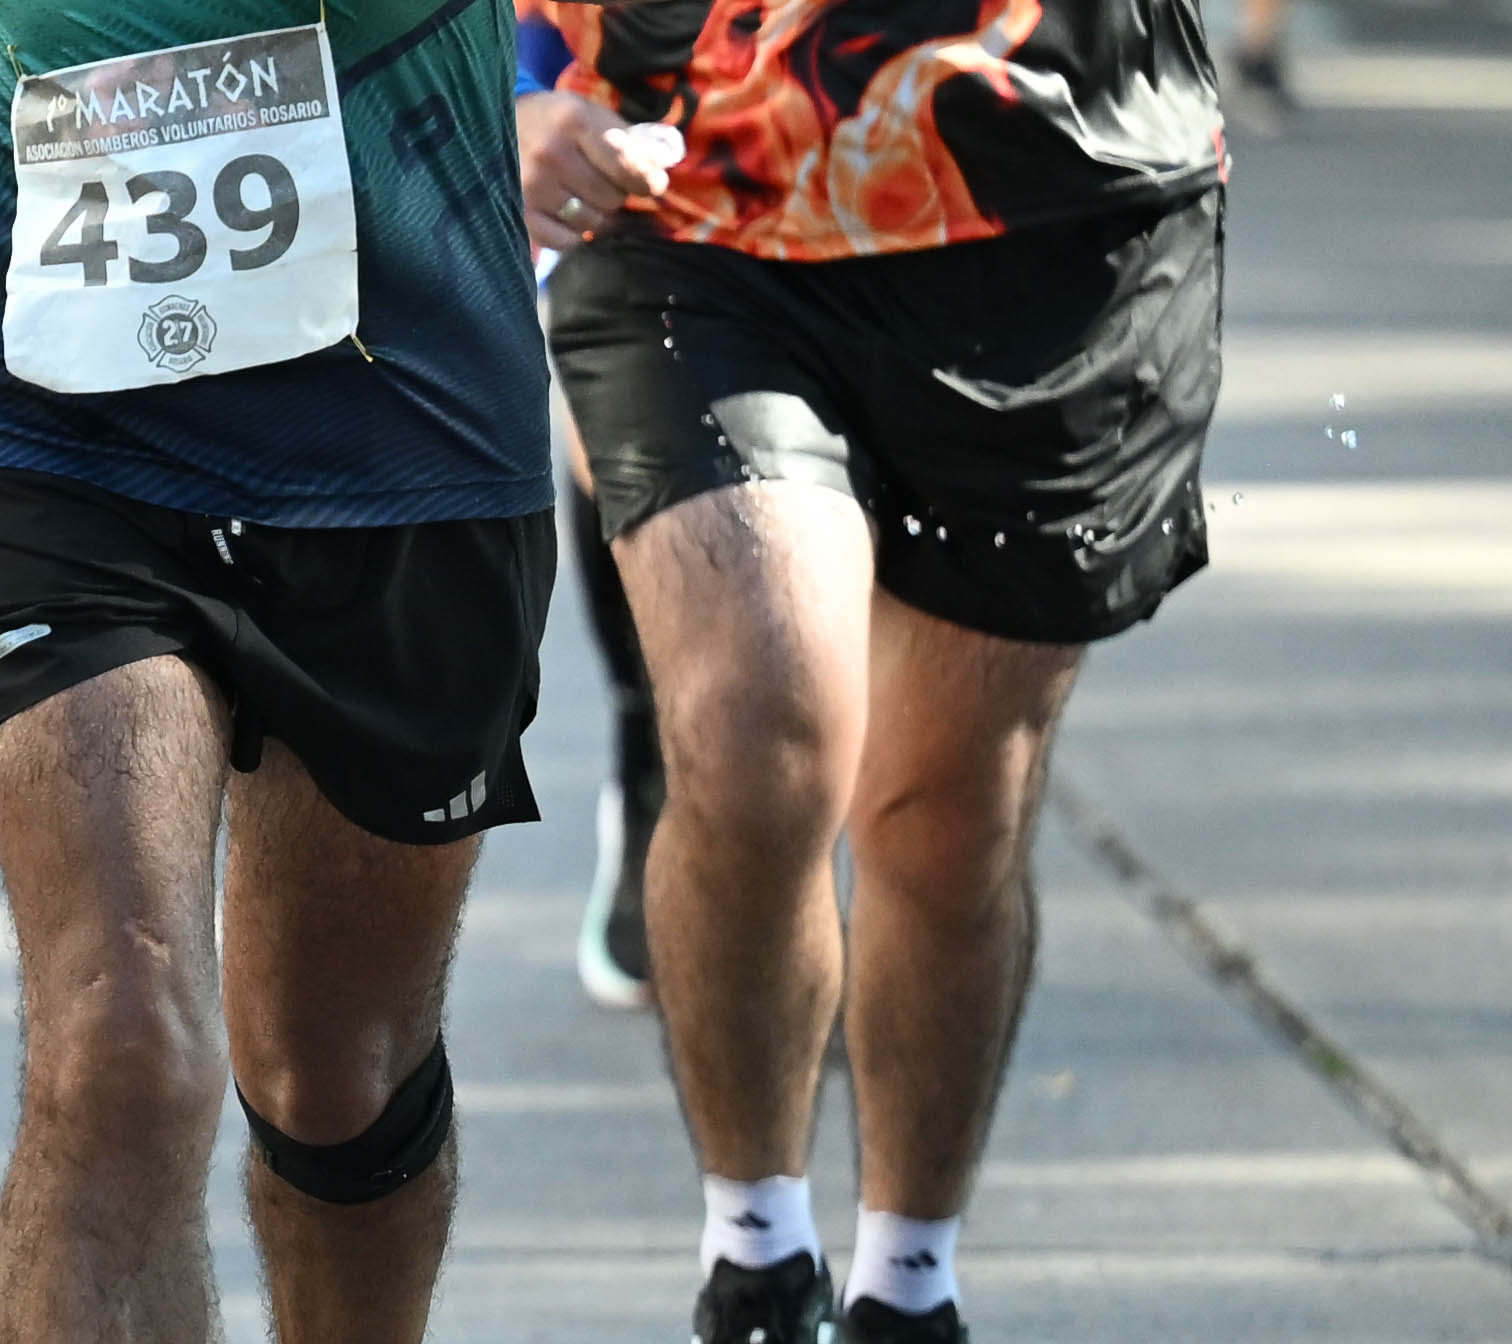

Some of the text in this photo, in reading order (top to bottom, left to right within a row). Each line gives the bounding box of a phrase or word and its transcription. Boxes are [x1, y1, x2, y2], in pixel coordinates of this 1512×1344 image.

[75, 51, 280, 130] MARATÓN
[83, 127, 159, 156] BOMBEROS
[161, 110, 257, 143] VOLUNTARIOS
[260, 99, 323, 126] ROSARIO
[39, 153, 300, 288] 439
[161, 319, 193, 347] 27
